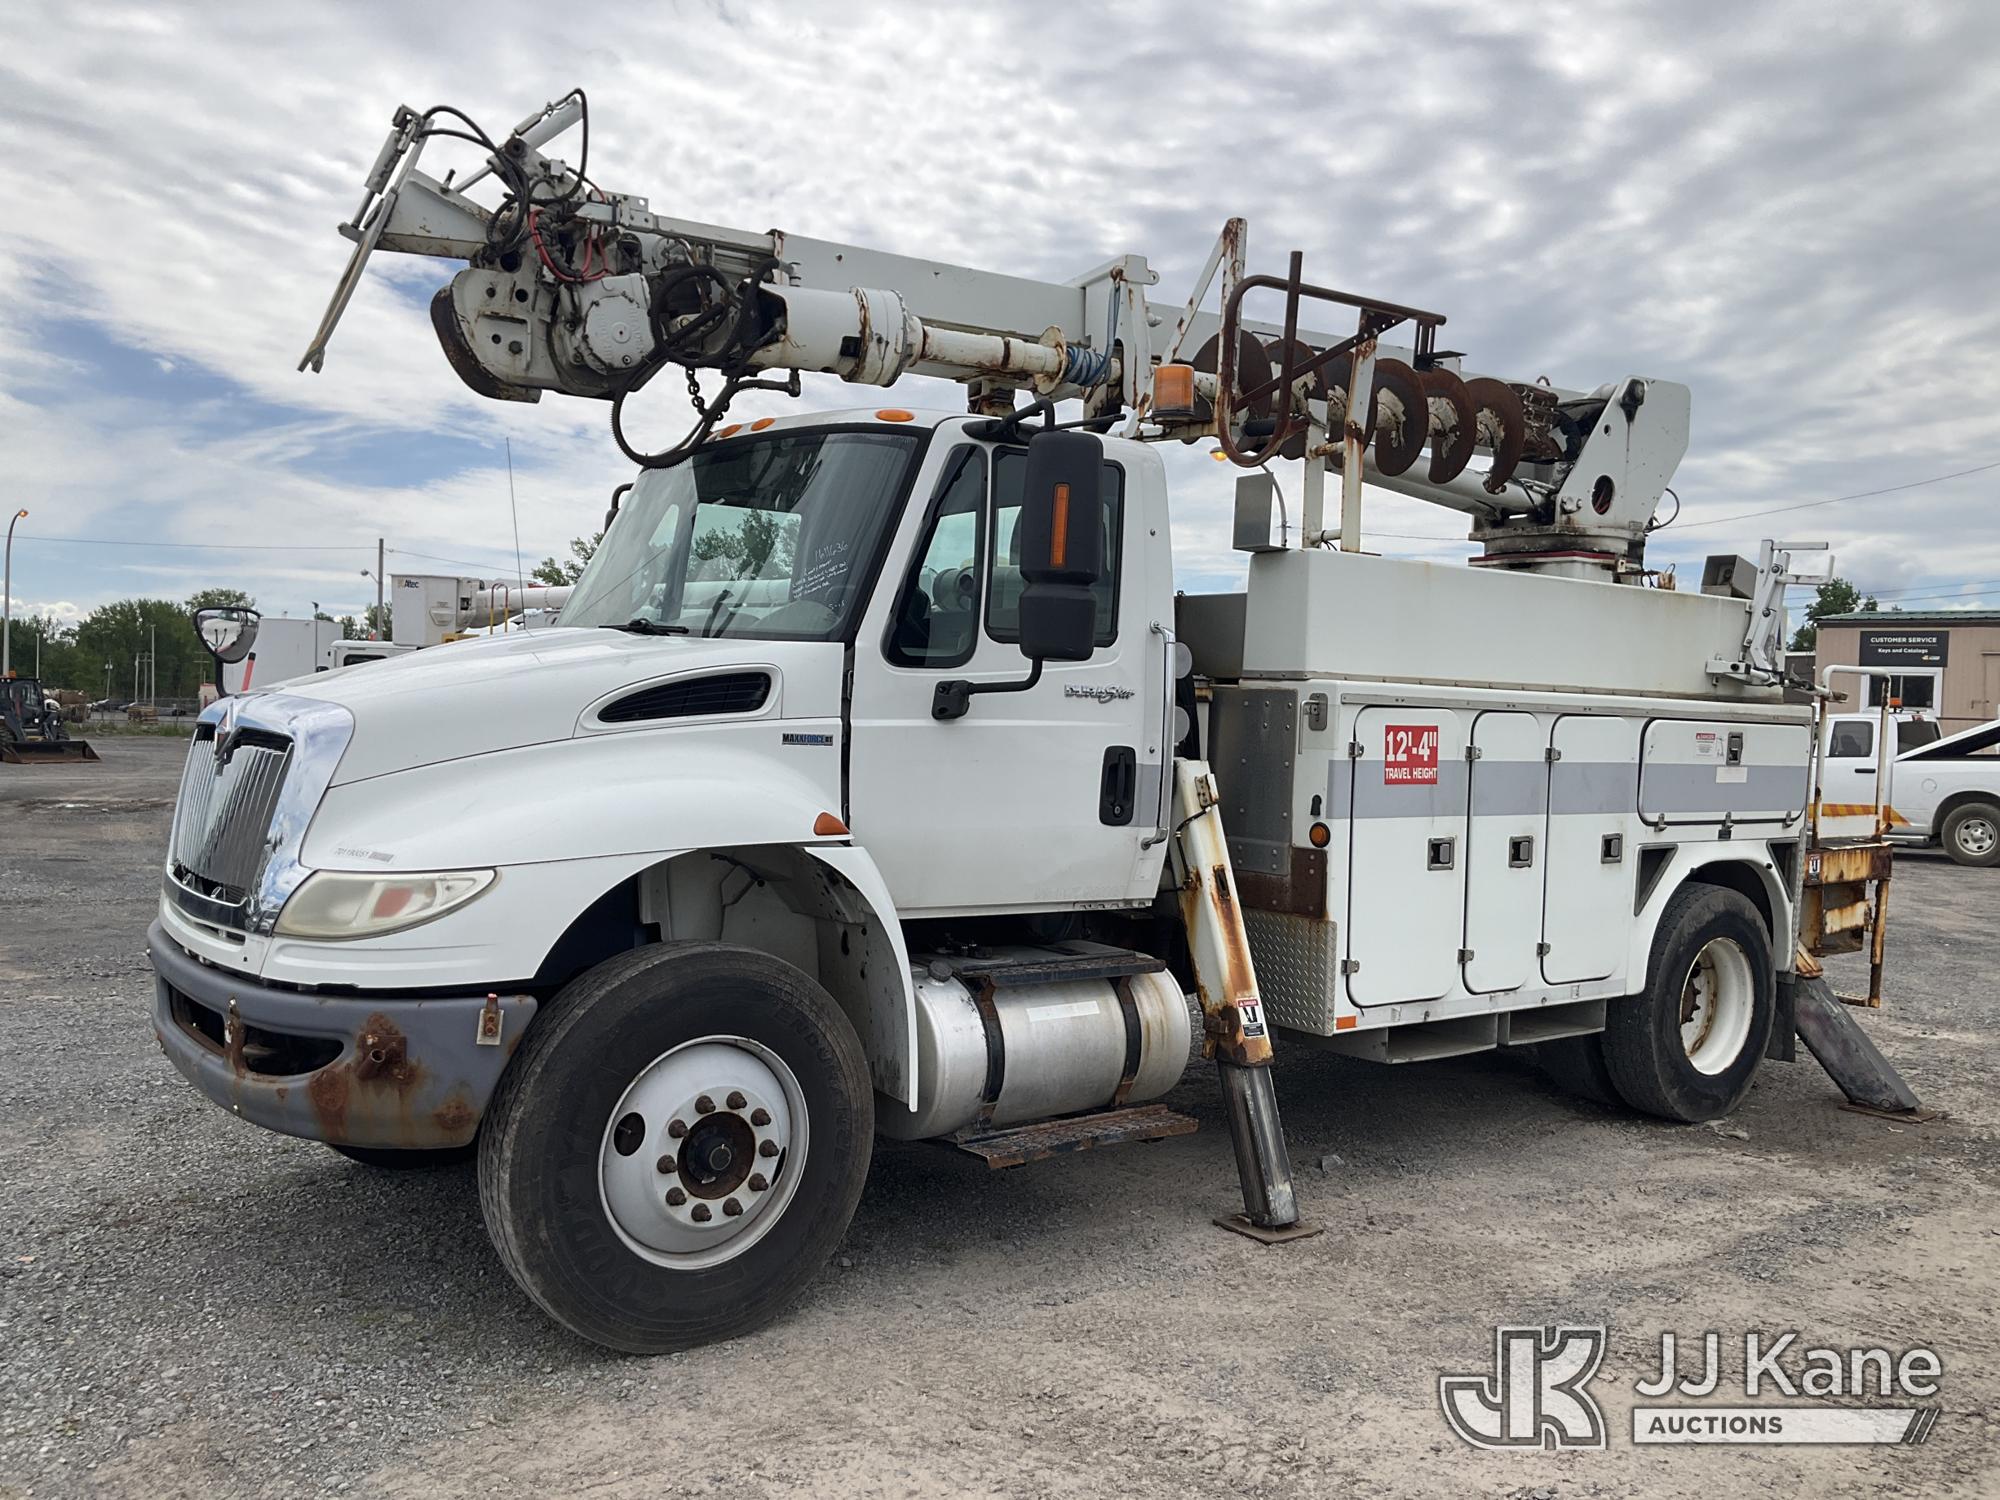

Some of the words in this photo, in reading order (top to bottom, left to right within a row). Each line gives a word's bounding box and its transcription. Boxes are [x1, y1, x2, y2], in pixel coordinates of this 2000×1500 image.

[404, 579, 419, 589] Altec
[1385, 767, 1411, 780] TRAVEL
[1412, 767, 1437, 779] HEIGHT
